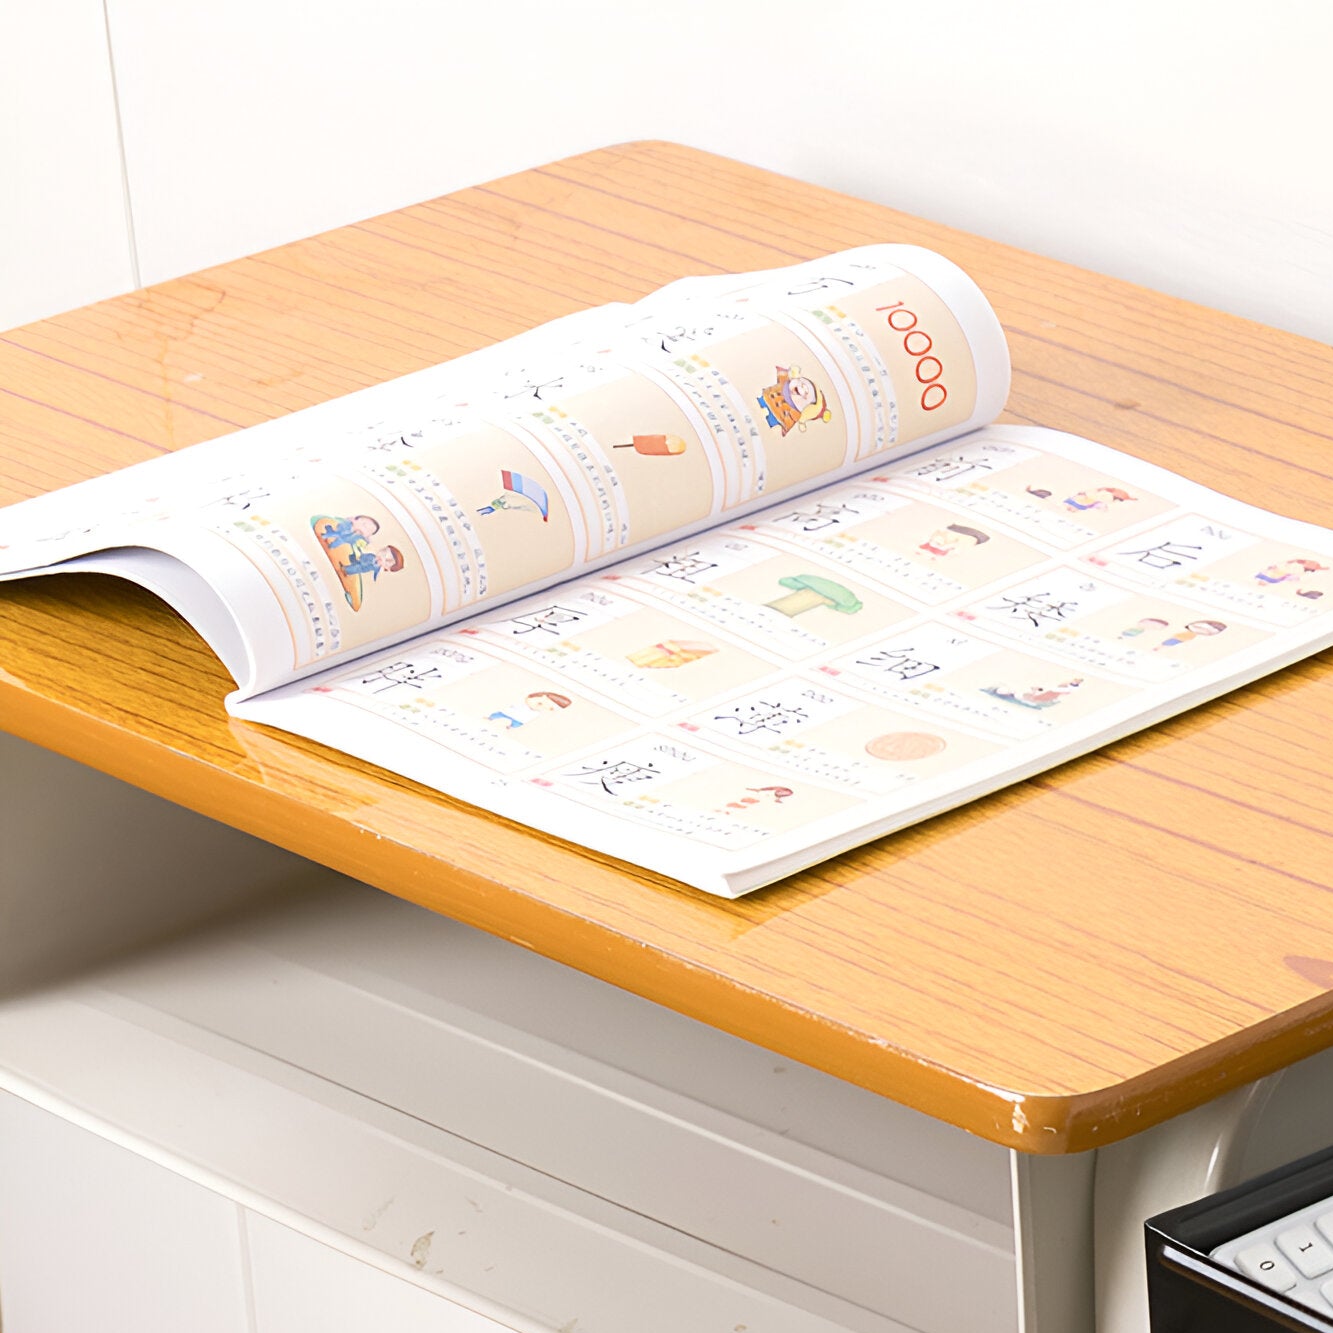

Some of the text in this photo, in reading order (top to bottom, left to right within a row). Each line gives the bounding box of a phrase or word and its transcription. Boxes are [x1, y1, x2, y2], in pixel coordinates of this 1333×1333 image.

[876, 301, 947, 411] 10000
[1298, 1242, 1313, 1254] 1
[1259, 1260, 1275, 1272] 0
